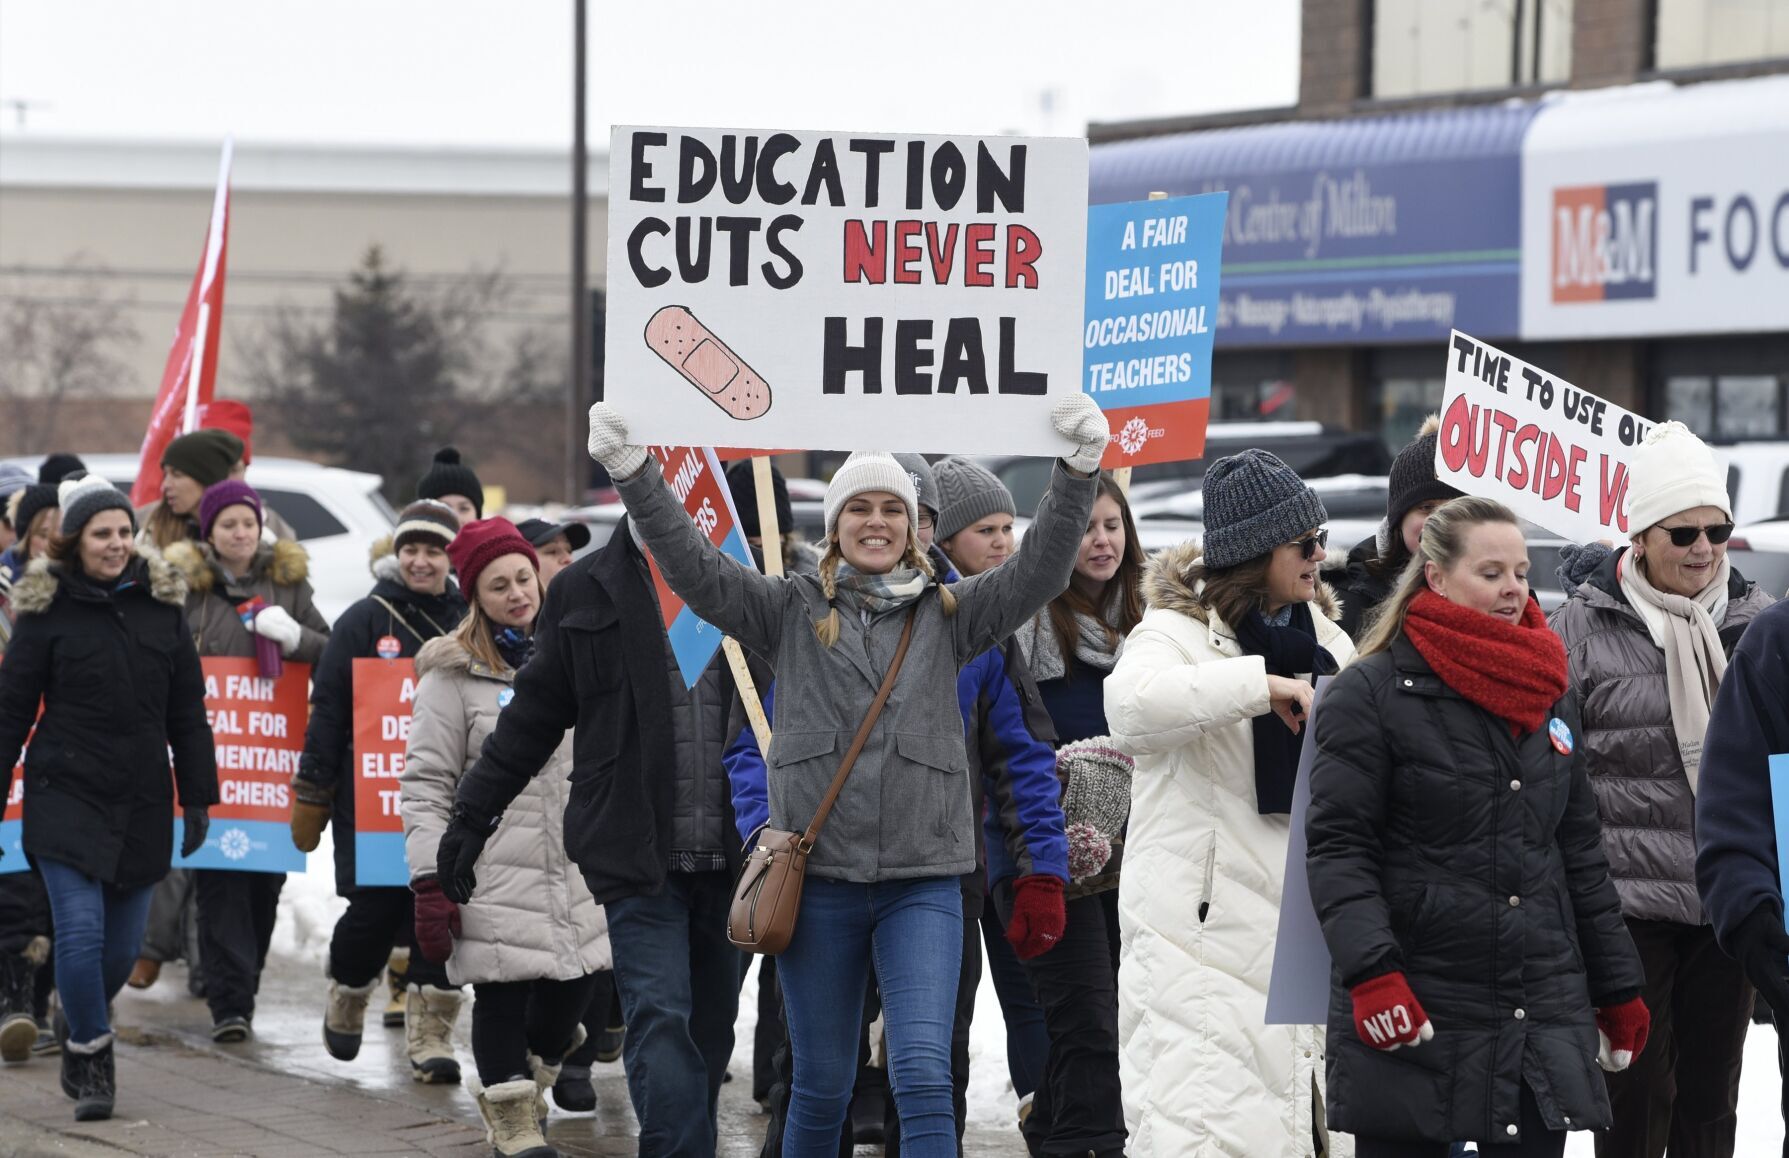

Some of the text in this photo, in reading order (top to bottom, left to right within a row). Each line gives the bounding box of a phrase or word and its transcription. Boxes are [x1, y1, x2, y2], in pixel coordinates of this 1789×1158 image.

[630, 132, 1027, 213] EDUCATION
[627, 214, 1042, 290] CUTS NEVER
[1121, 215, 1188, 250] A FAIR
[1556, 198, 1653, 288] M&M
[1104, 260, 1198, 300] DEAL FOR
[1085, 305, 1208, 348] OCCASIONAL
[822, 316, 1048, 397] HEAL
[1089, 352, 1192, 393] TEACHERS
[1453, 335, 1651, 447] TIME TO USE OU
[1440, 393, 1588, 513] OUTSIDE
[205, 675, 275, 701] A FAIR
[399, 677, 415, 703] A
[248, 711, 288, 739] FOR
[381, 715, 413, 741] DE
[215, 744, 302, 774] MENTARY
[362, 752, 404, 778] ELE
[220, 779, 290, 808] CHERS
[1363, 1004, 1413, 1044] CAN
